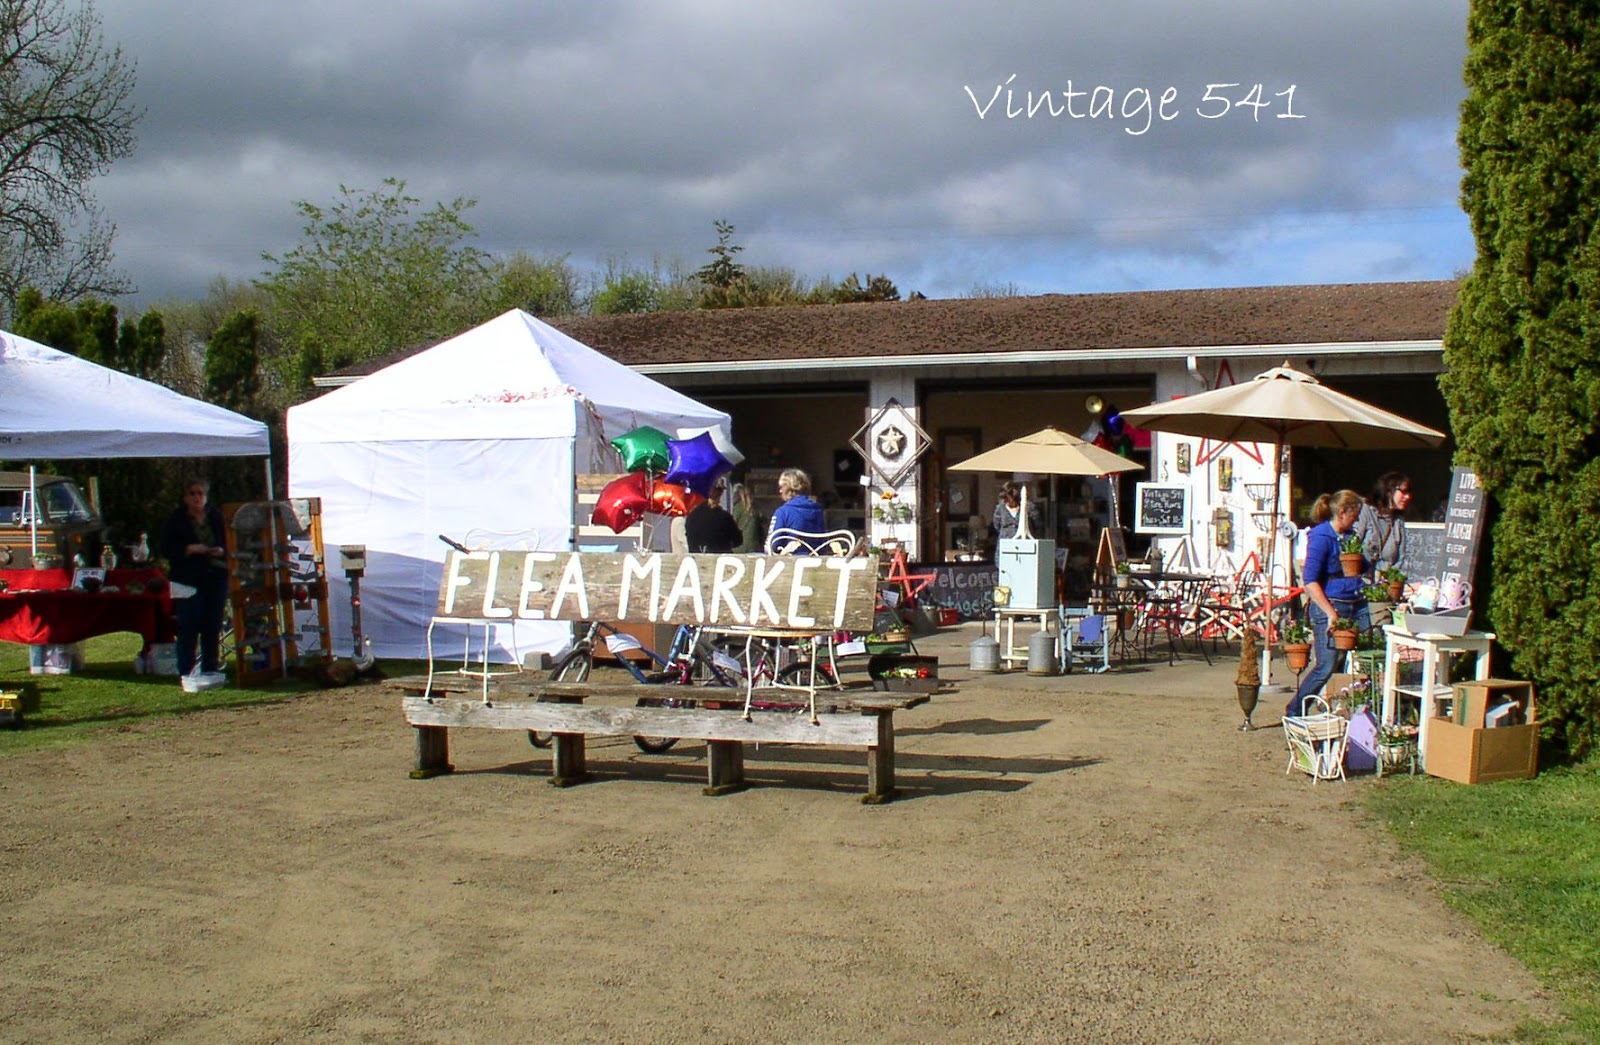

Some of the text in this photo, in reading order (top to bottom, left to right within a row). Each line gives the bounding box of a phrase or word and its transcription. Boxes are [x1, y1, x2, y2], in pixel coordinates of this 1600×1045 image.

[1459, 473, 1477, 490] LIVE
[1454, 493, 1476, 503] EVERY
[1449, 507, 1477, 518] MOMENT
[1446, 522, 1473, 540] LAUGH
[1446, 543, 1467, 554] EVERY
[1447, 557, 1460, 567] DAY
[444, 550, 867, 628] FLEA MARKET
